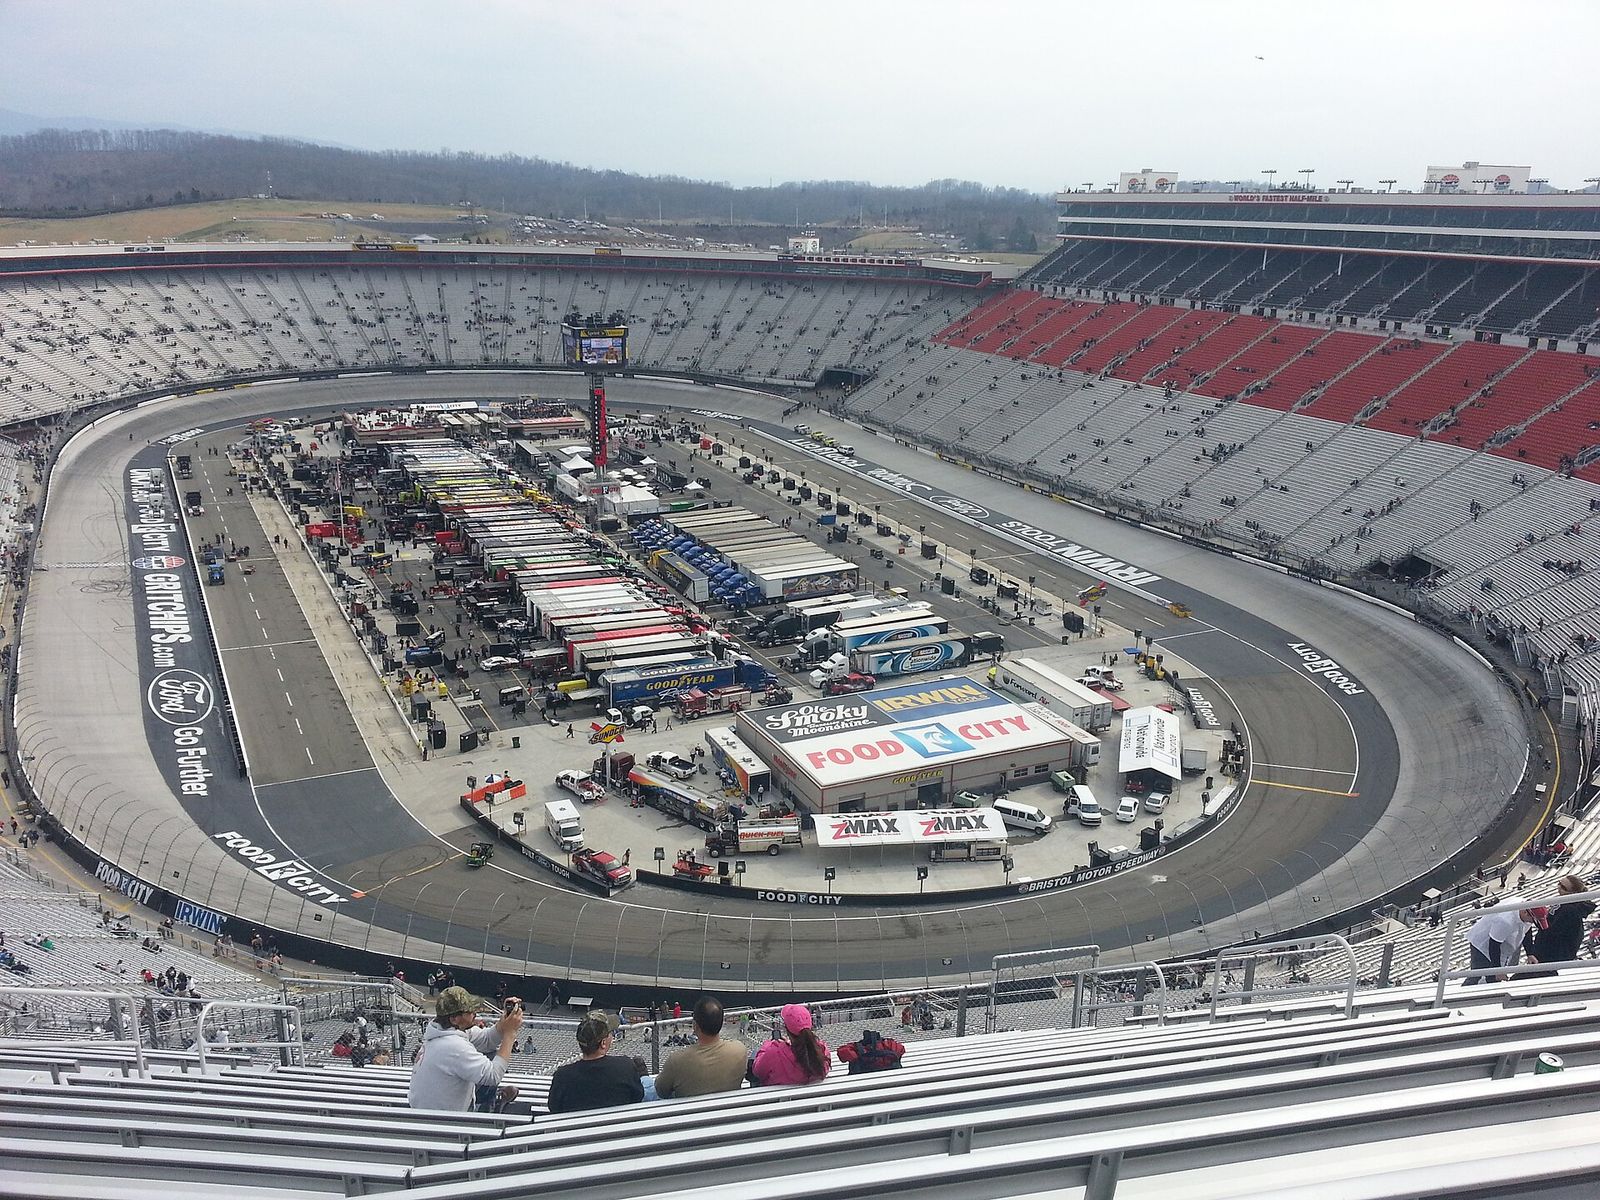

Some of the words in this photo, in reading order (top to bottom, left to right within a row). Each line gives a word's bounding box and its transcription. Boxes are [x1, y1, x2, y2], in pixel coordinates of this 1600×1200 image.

[142, 533, 170, 551] CITY
[1000, 520, 1064, 548] TOOLS
[1056, 544, 1162, 585] IRWIN
[1287, 642, 1321, 662] CITY
[641, 663, 714, 676] GOODYEAR
[646, 674, 715, 690] GOODYEAR
[1010, 678, 1037, 699] Forward
[1324, 670, 1365, 696] FOOD
[799, 705, 836, 716] Ole
[872, 684, 983, 712] IRWIN
[766, 704, 868, 729] Smoky
[787, 719, 878, 738] Moonshine
[173, 726, 203, 746] Go
[591, 725, 625, 744] SUNOCO
[806, 739, 905, 770] FOOD
[957, 715, 1031, 741] CITY
[1136, 725, 1149, 759] Nationwide
[176, 747, 213, 796] Further
[893, 769, 944, 784] GOODYEAR
[739, 830, 785, 840] QUICK-FUEL
[214, 831, 276, 864] FOOD
[288, 875, 349, 905] CITY
[521, 847, 534, 860] BUILT
[551, 863, 570, 879] TOUGH
[1029, 873, 1073, 892] BRISTOL
[1077, 865, 1112, 883] MOTOR
[1114, 848, 1160, 872] SPEEDWAY
[95, 861, 120, 889] FOOD
[127, 881, 154, 905] CITY
[757, 891, 797, 902] FOOD
[809, 895, 842, 904] CITY
[175, 901, 229, 936] IRWIN
